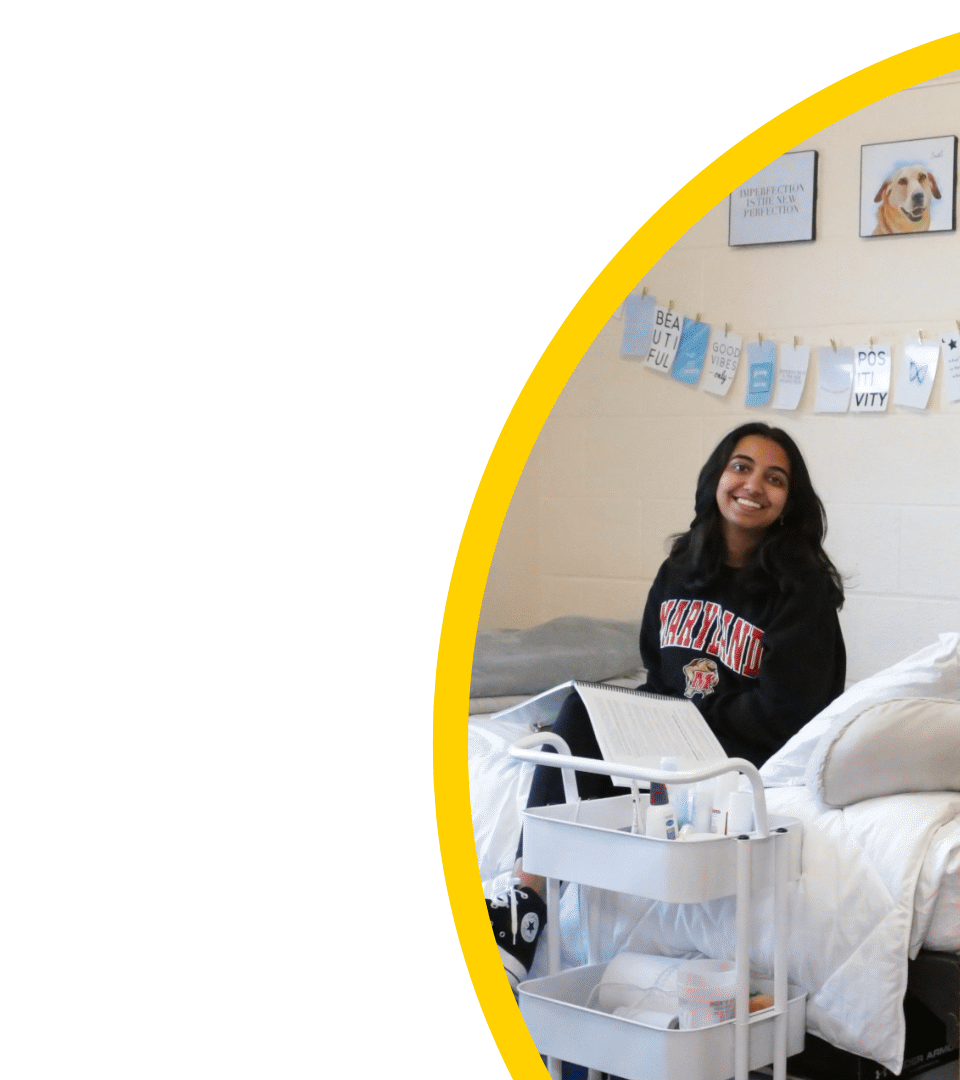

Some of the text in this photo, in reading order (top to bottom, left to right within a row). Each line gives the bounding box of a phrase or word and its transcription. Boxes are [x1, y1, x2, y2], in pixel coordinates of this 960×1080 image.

[739, 184, 805, 198] IMPERFECTION
[746, 195, 796, 207] IS THE NEW
[743, 205, 800, 217] PERFECTION
[655, 310, 680, 331] BEA
[652, 329, 679, 351] UTI
[712, 342, 741, 358] GOOD
[646, 348, 669, 369] FUL
[711, 354, 737, 371] VIBES
[858, 351, 886, 366] POS
[714, 370, 727, 385] only
[857, 370, 875, 387] ITI
[855, 392, 888, 407] VITY
[659, 599, 765, 679] MARYLAND
